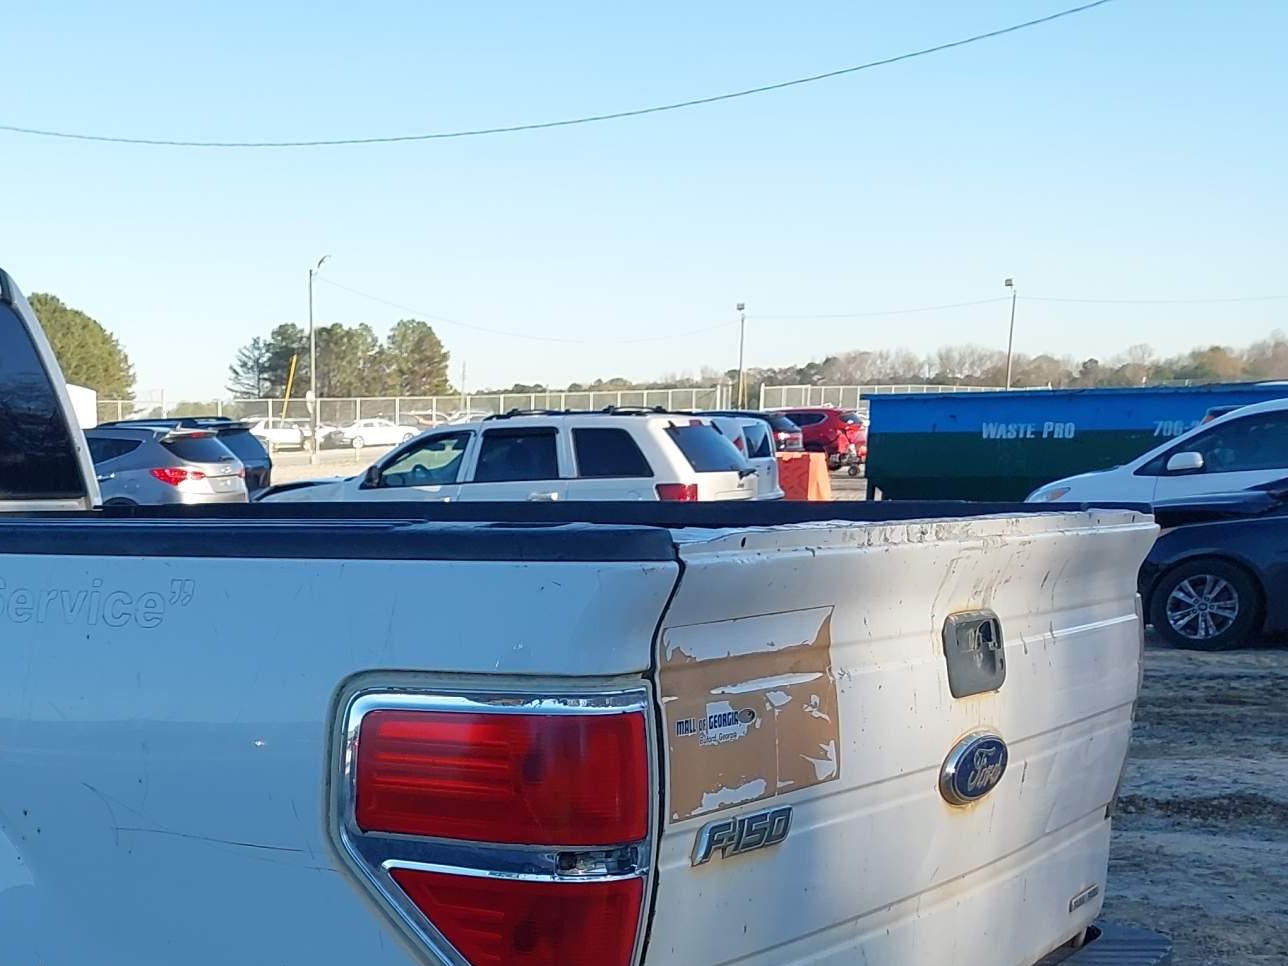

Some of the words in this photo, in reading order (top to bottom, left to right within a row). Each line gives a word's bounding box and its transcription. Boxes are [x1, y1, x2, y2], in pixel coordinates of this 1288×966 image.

[982, 422, 1035, 439] WASTE
[1042, 421, 1075, 439] PRO
[676, 718, 697, 737] MALL
[708, 710, 740, 730] GEORGIA
[967, 746, 1004, 792] Ford
